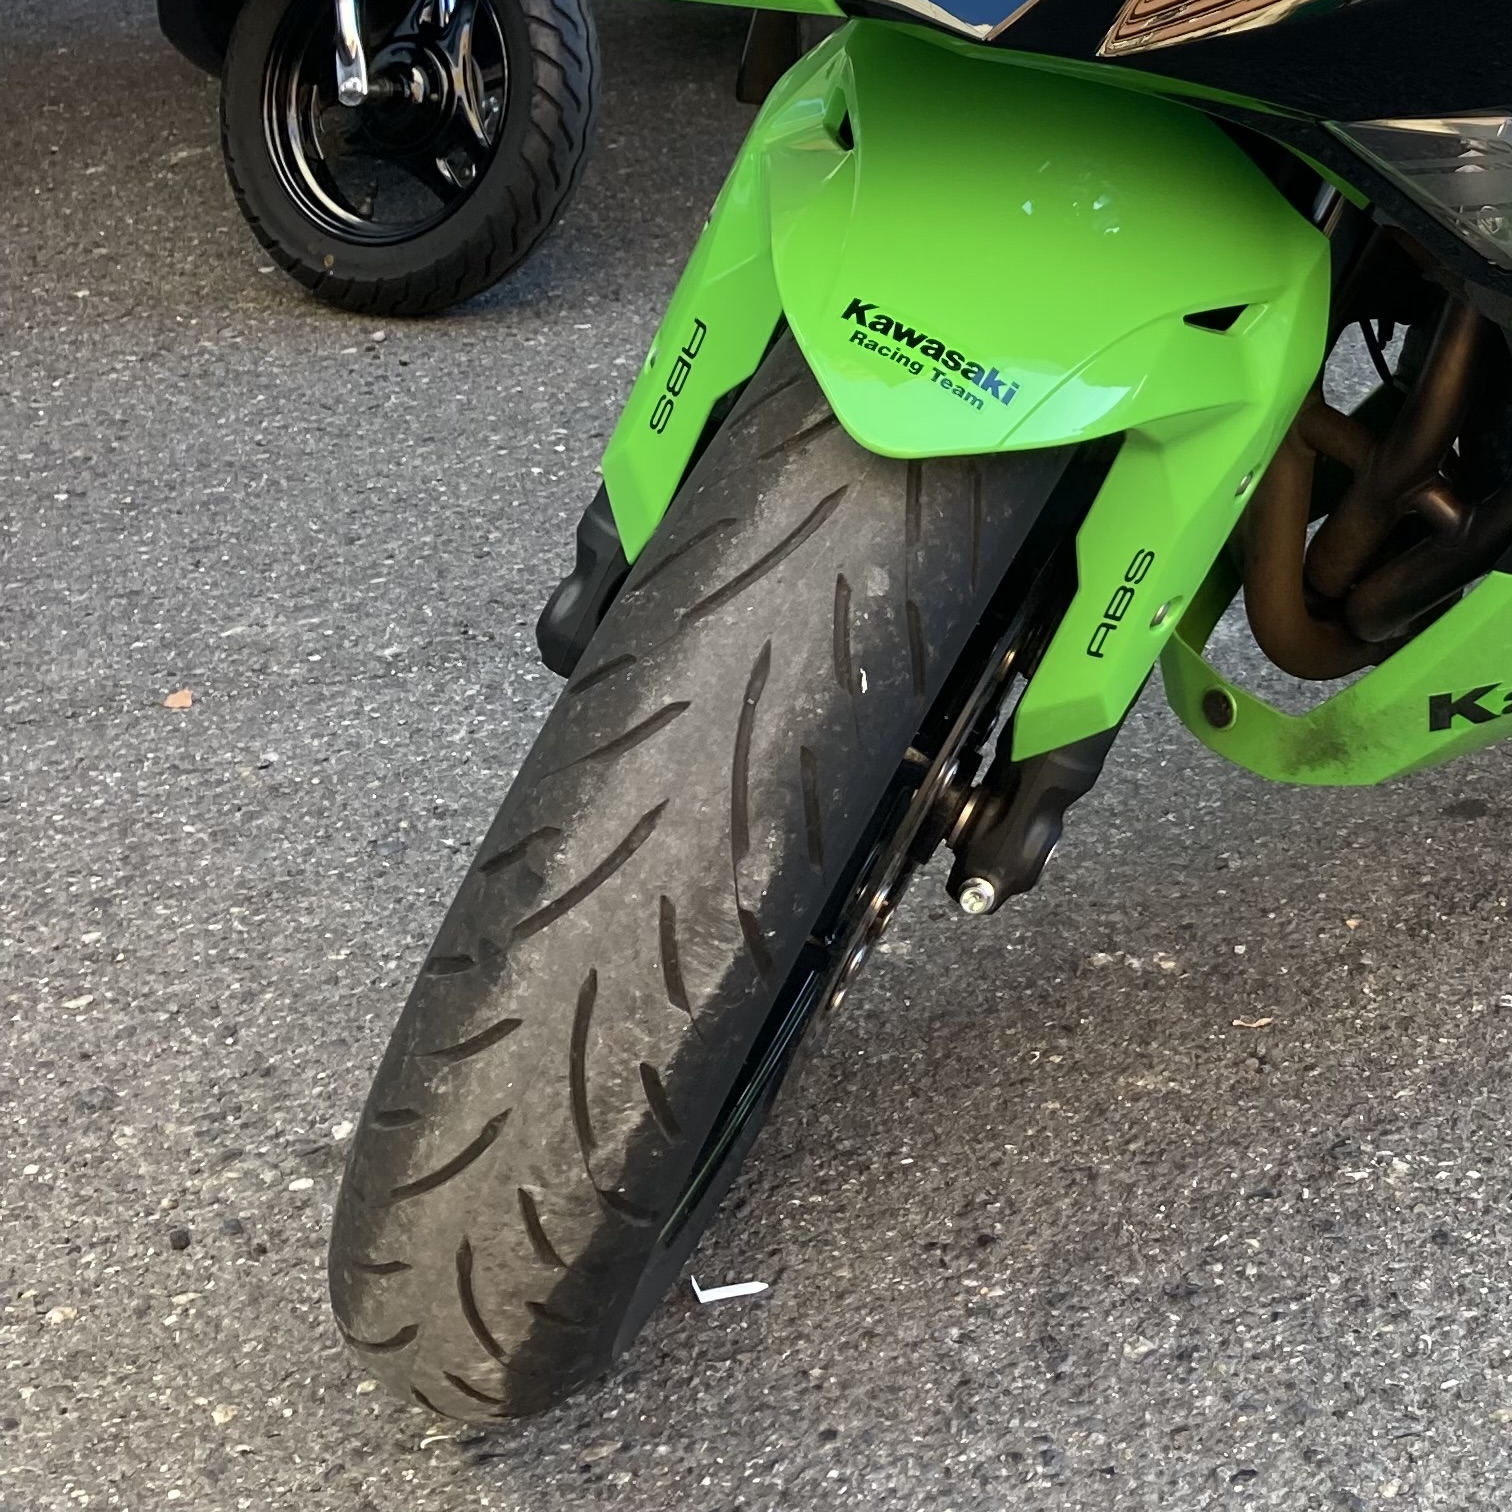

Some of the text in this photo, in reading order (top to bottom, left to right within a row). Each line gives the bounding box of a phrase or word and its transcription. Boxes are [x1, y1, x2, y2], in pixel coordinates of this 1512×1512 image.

[649, 316, 707, 435] ABS
[841, 297, 1021, 406] Kawasaki
[849, 329, 985, 411] Racing Team
[1086, 548, 1155, 659] ABS
